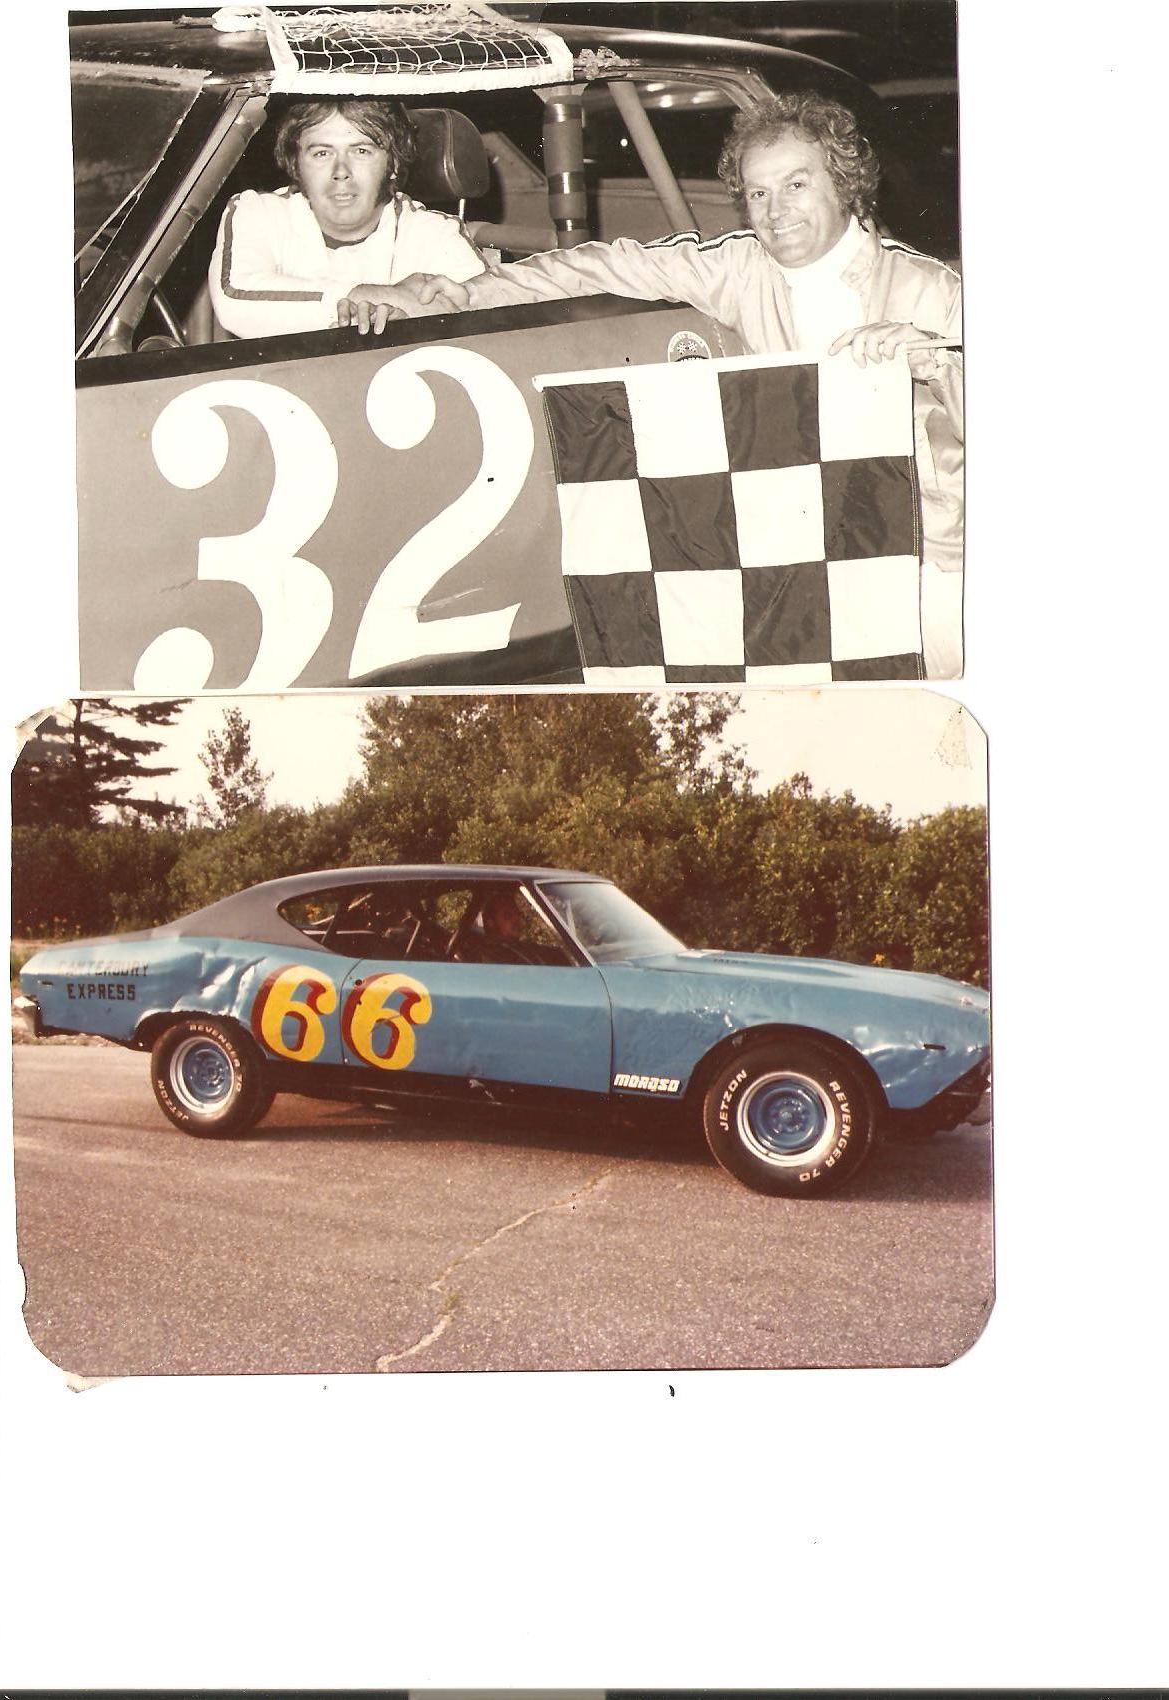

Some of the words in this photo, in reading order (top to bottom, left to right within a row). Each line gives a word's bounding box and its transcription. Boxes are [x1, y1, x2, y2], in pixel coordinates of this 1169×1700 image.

[134, 346, 535, 690] 32
[66, 983, 136, 1001] EXPRESS
[251, 964, 432, 1071] 66
[189, 1024, 241, 1068] REVENGER
[157, 1079, 189, 1121] JETZON
[719, 1069, 747, 1131] JETZON
[825, 1080, 852, 1168] REVENGER
[799, 1168, 821, 1182] 70
